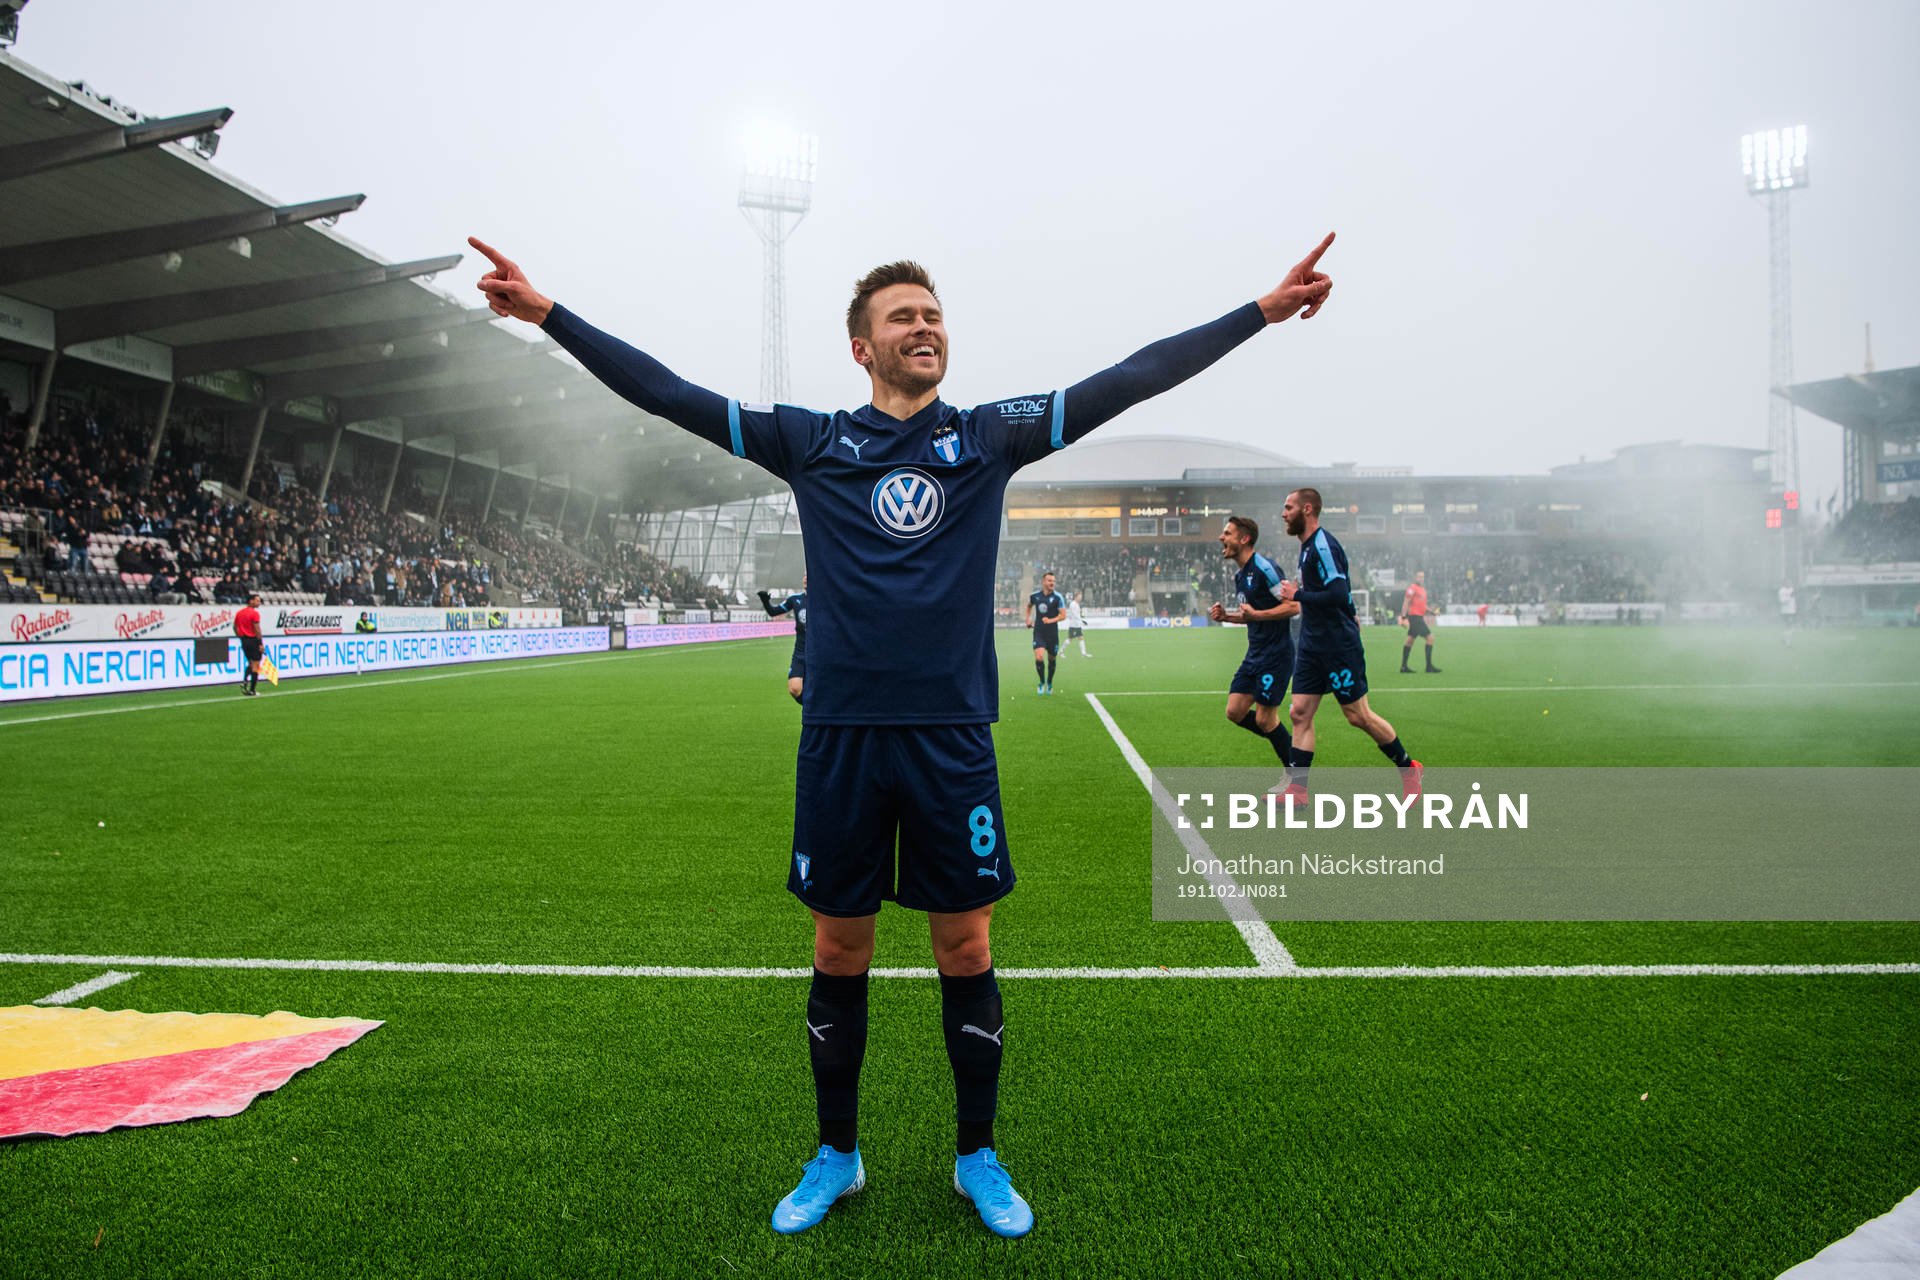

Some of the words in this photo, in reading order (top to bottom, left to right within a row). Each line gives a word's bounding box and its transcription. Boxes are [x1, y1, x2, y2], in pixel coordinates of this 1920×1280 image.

[997, 399, 1048, 413] TICTAC
[64, 649, 165, 686] NERCIA
[264, 642, 329, 670] NERCIA
[335, 640, 387, 665] NERCIA
[393, 638, 437, 661] NERCIA
[441, 636, 477, 657] NERCIA
[481, 634, 518, 654] NERCIA
[1261, 673, 1274, 690] 9
[1329, 669, 1354, 689] 32
[968, 805, 996, 857] 8
